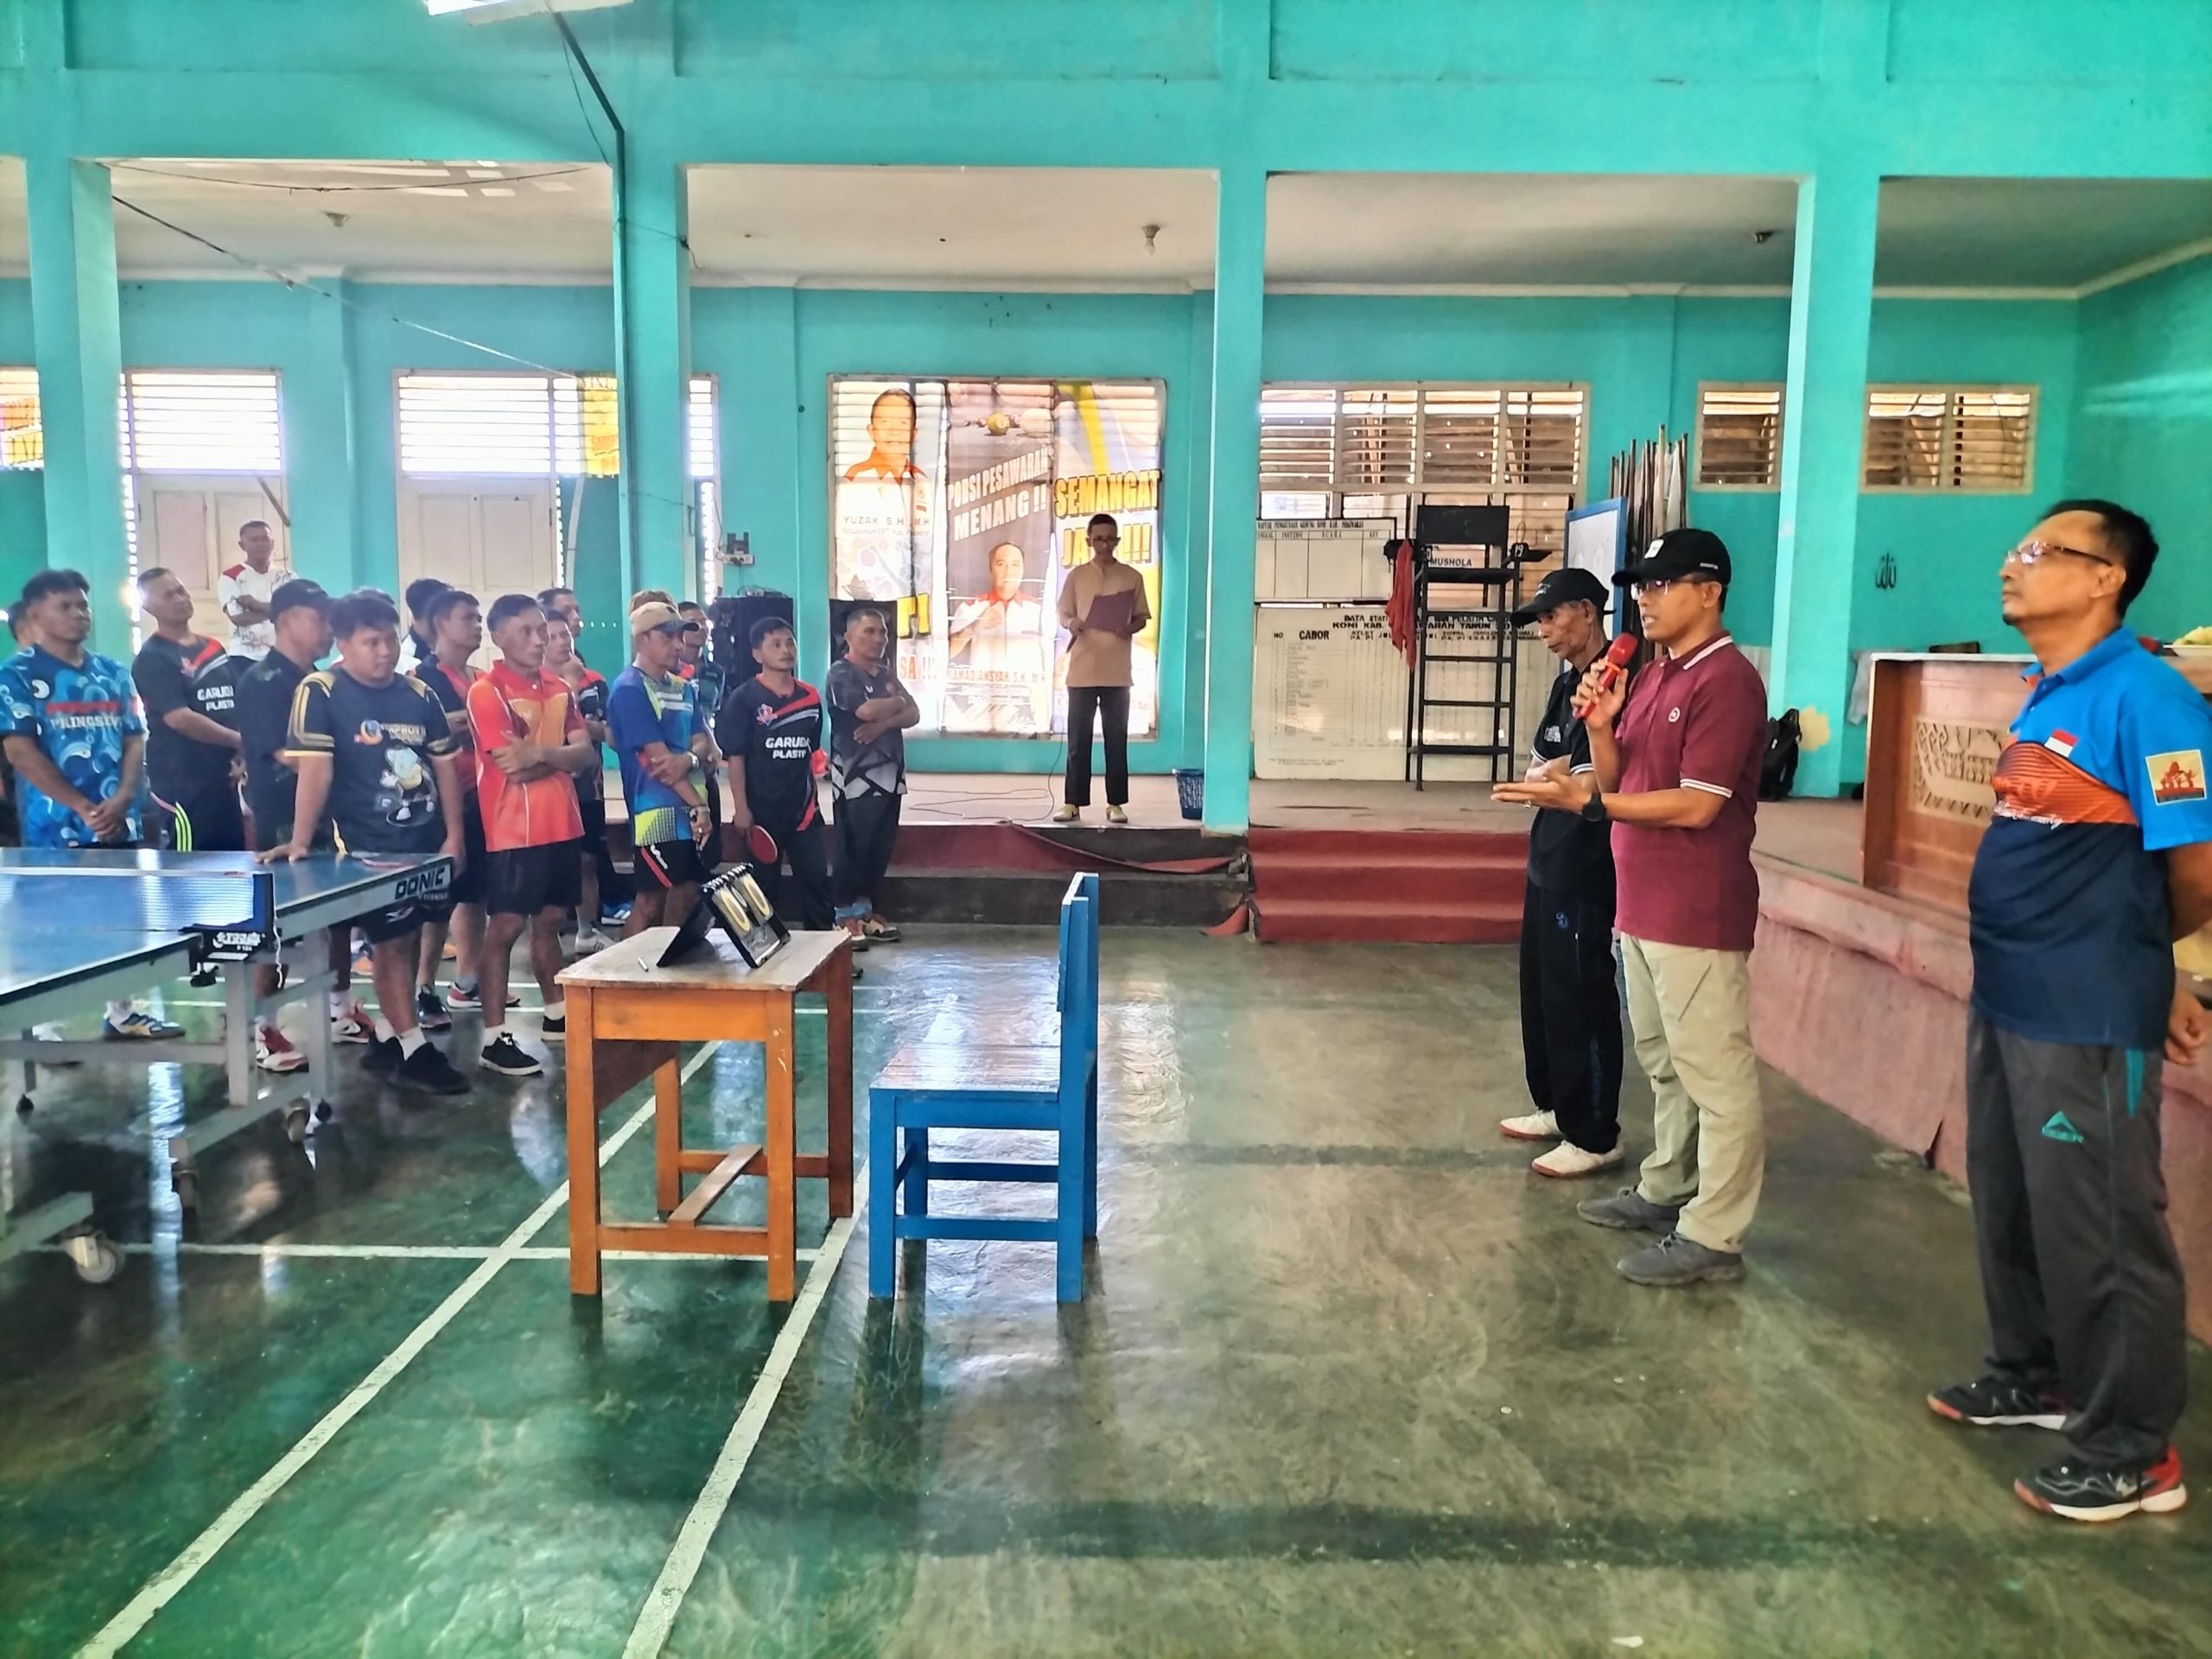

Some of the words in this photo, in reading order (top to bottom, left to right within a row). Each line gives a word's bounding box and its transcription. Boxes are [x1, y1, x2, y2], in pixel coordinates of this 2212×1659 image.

[947, 473, 981, 510] POBSI
[982, 447, 1048, 497] PESAWARAN
[1054, 469, 1162, 518] SEMANGAT
[843, 516, 879, 524] YUZAK
[954, 490, 1030, 542] MENANG
[1514, 544, 1524, 557] 19
[1430, 558, 1472, 567] MUSHOLA
[1299, 630, 1330, 640] CABOR
[772, 749, 806, 760] PLASTI
[395, 867, 446, 899] DONIC
